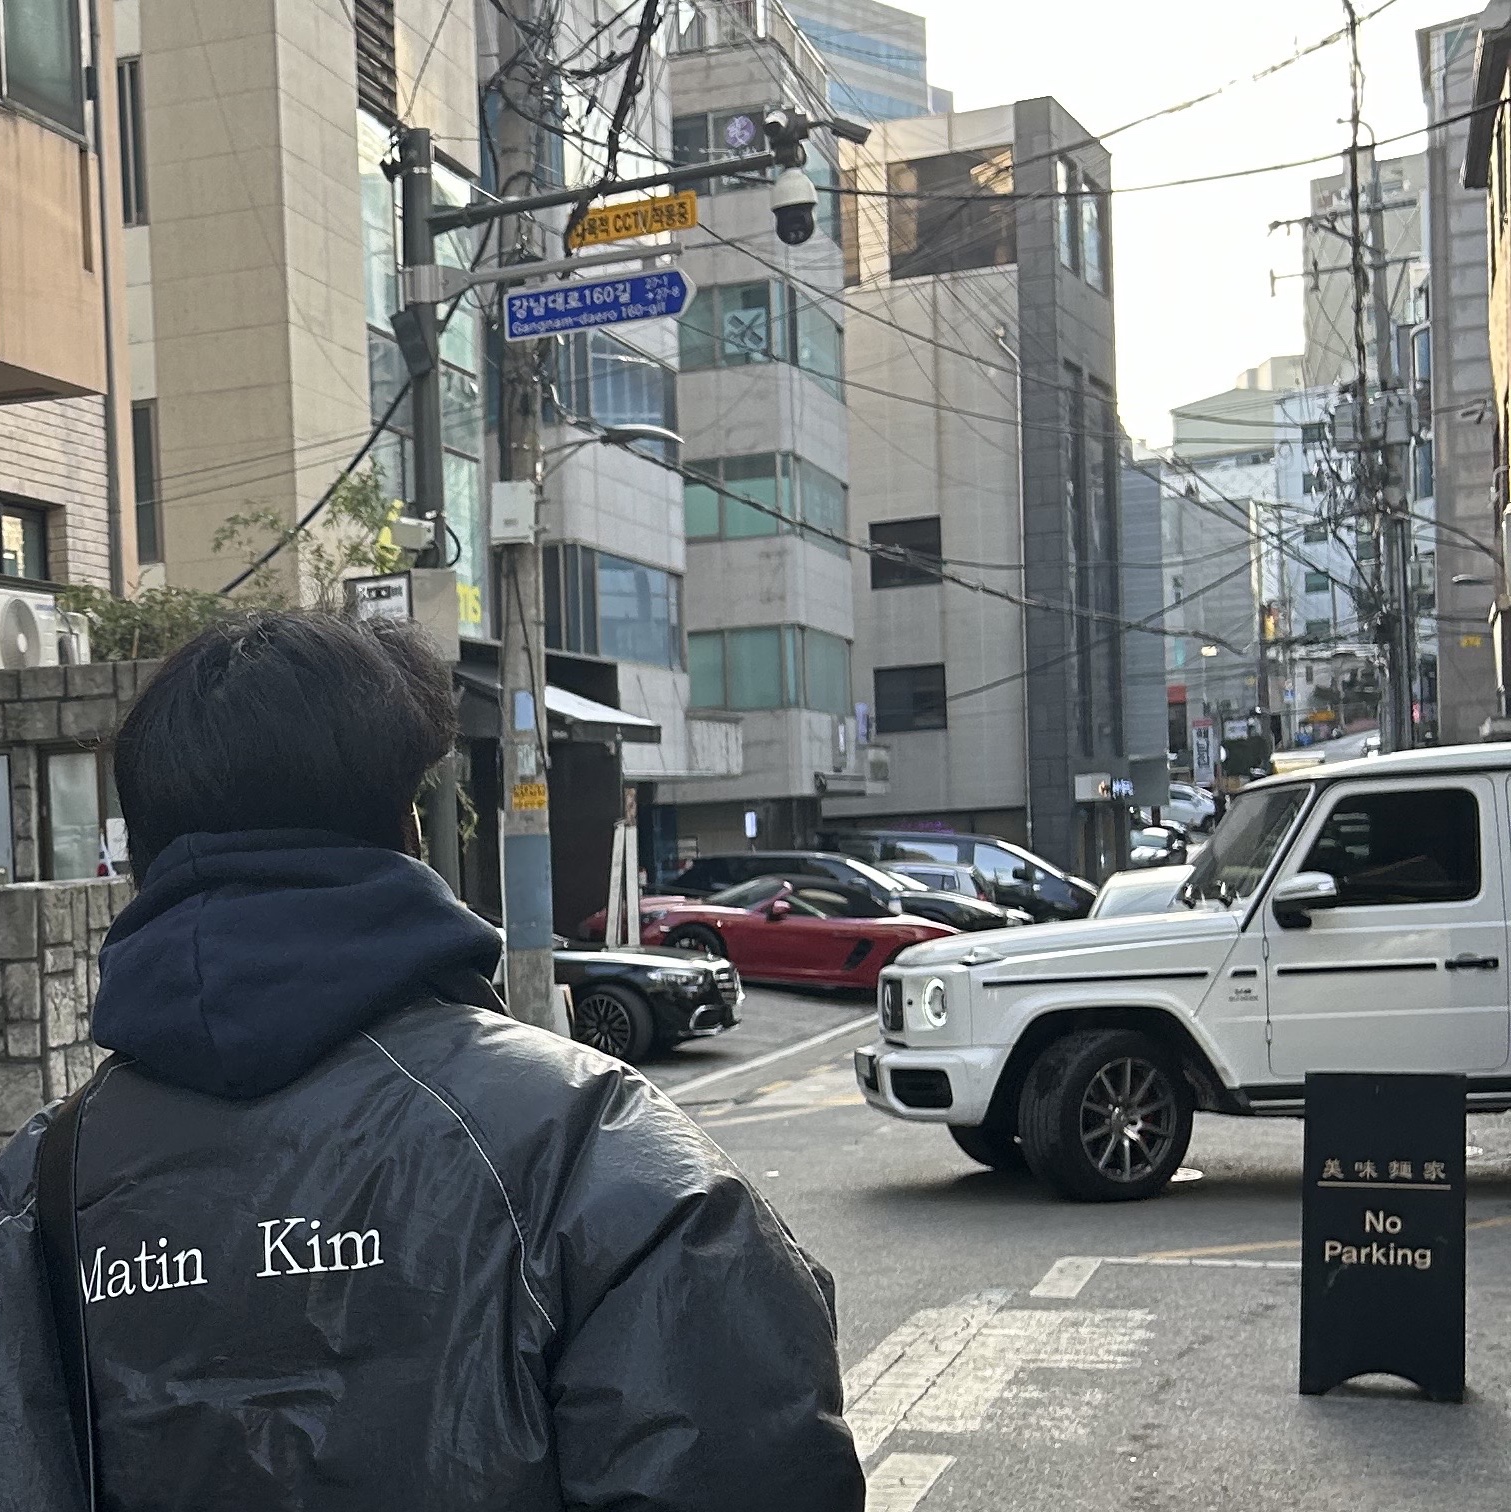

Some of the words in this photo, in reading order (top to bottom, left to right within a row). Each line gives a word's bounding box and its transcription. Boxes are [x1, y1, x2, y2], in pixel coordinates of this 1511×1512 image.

[512, 281, 631, 319] 강남대로160길
[511, 309, 618, 335] Gangnam-daero
[620, 301, 666, 319] 160-gil
[1364, 1210, 1402, 1234] No
[256, 1217, 385, 1278] Kim
[1324, 1240, 1432, 1270] Parking
